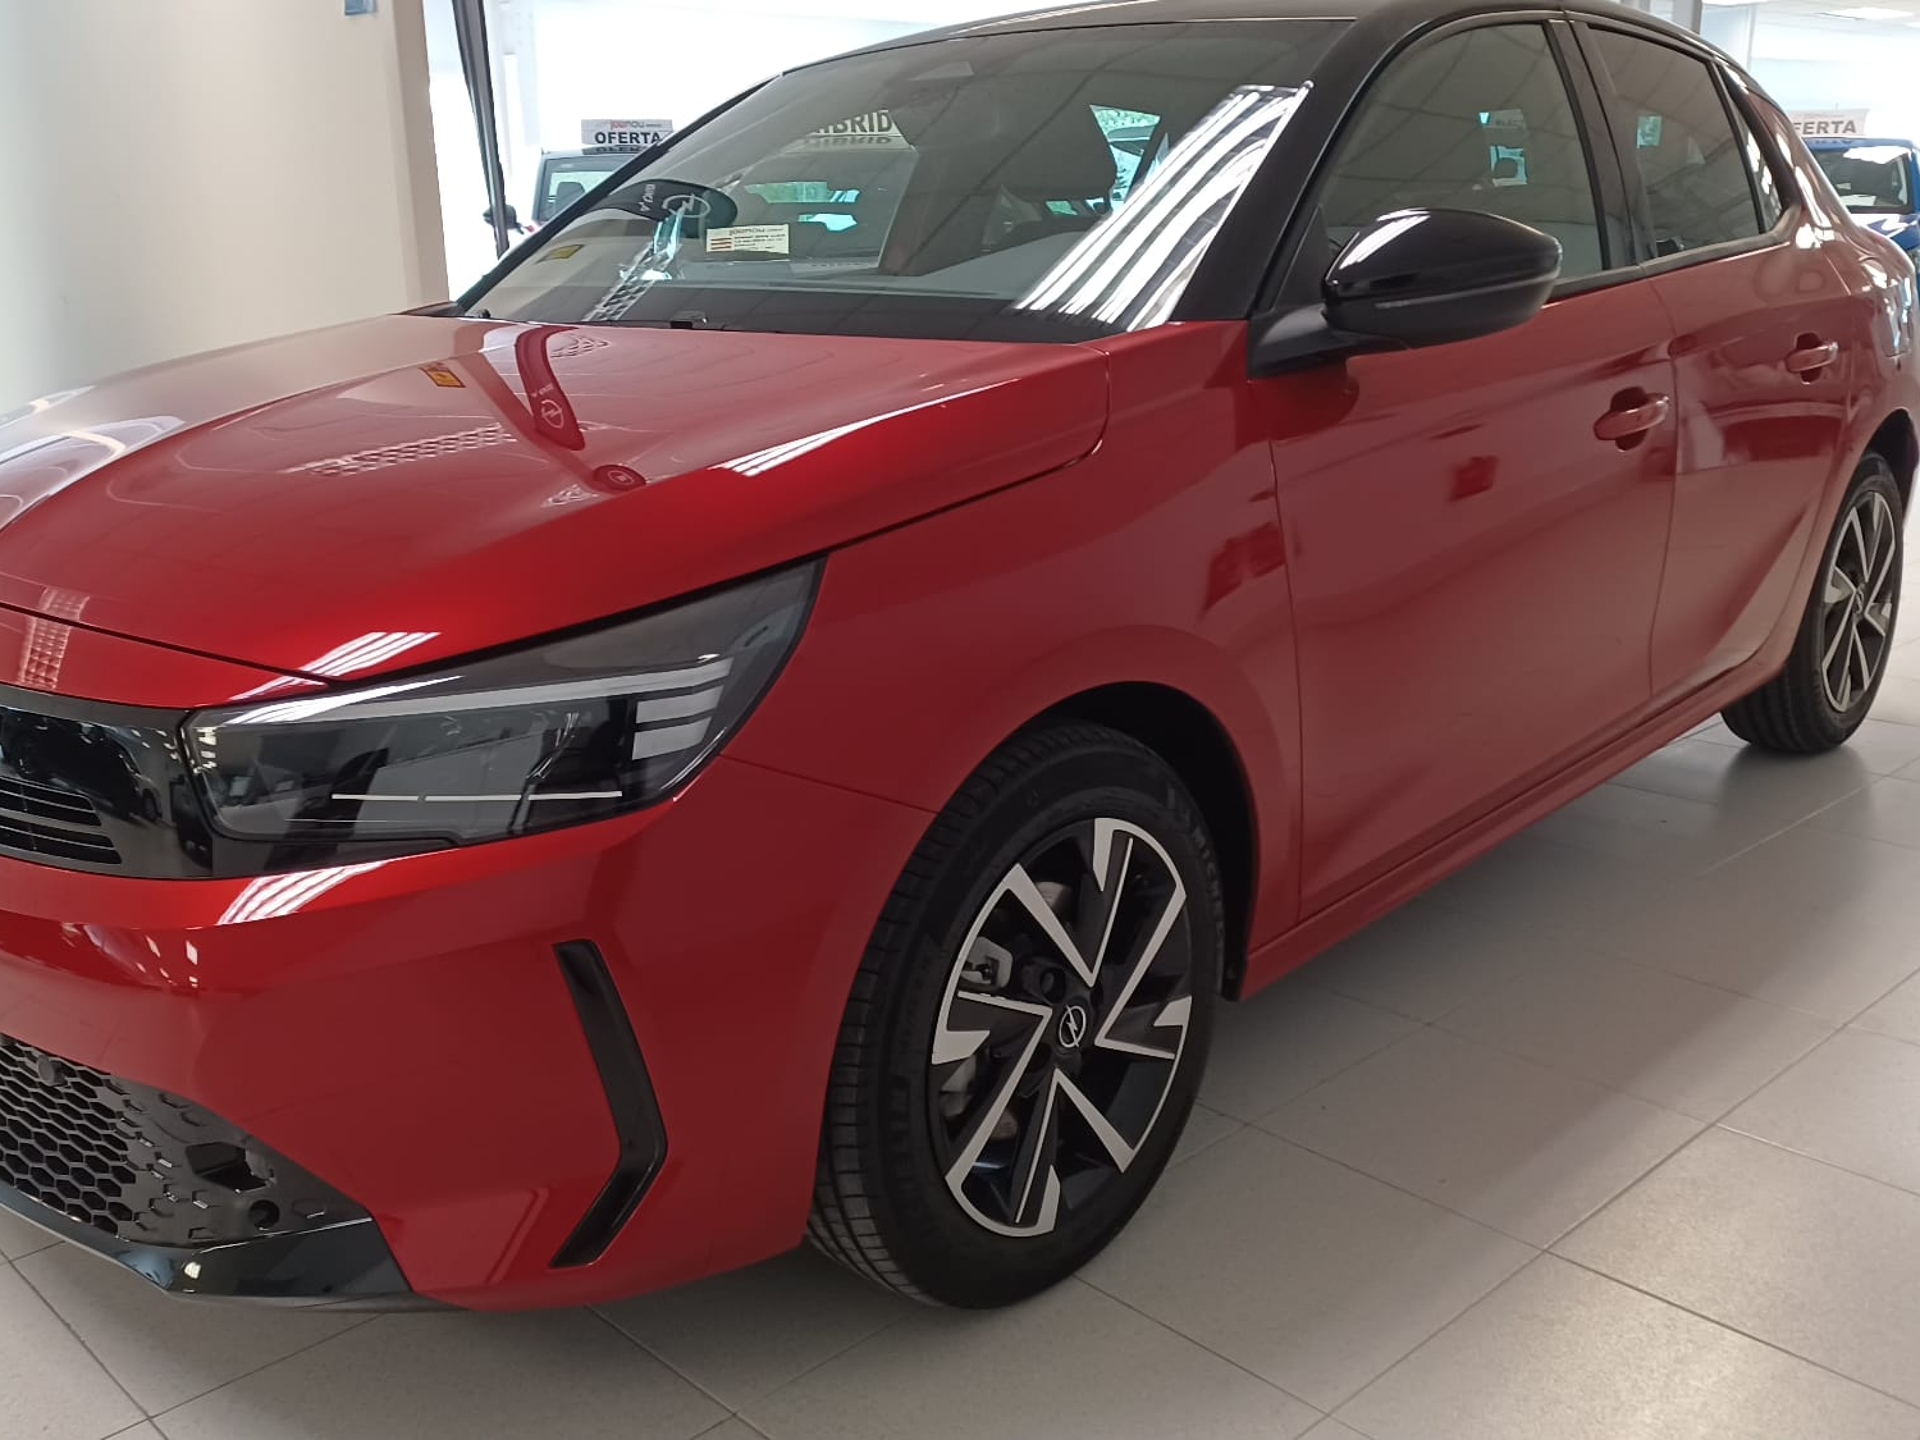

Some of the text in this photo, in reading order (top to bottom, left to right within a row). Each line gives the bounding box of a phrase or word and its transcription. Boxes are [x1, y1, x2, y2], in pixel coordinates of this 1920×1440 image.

[811, 111, 893, 133] BRID
[1793, 120, 1857, 135] FERTA
[594, 131, 663, 144] OFERTA
